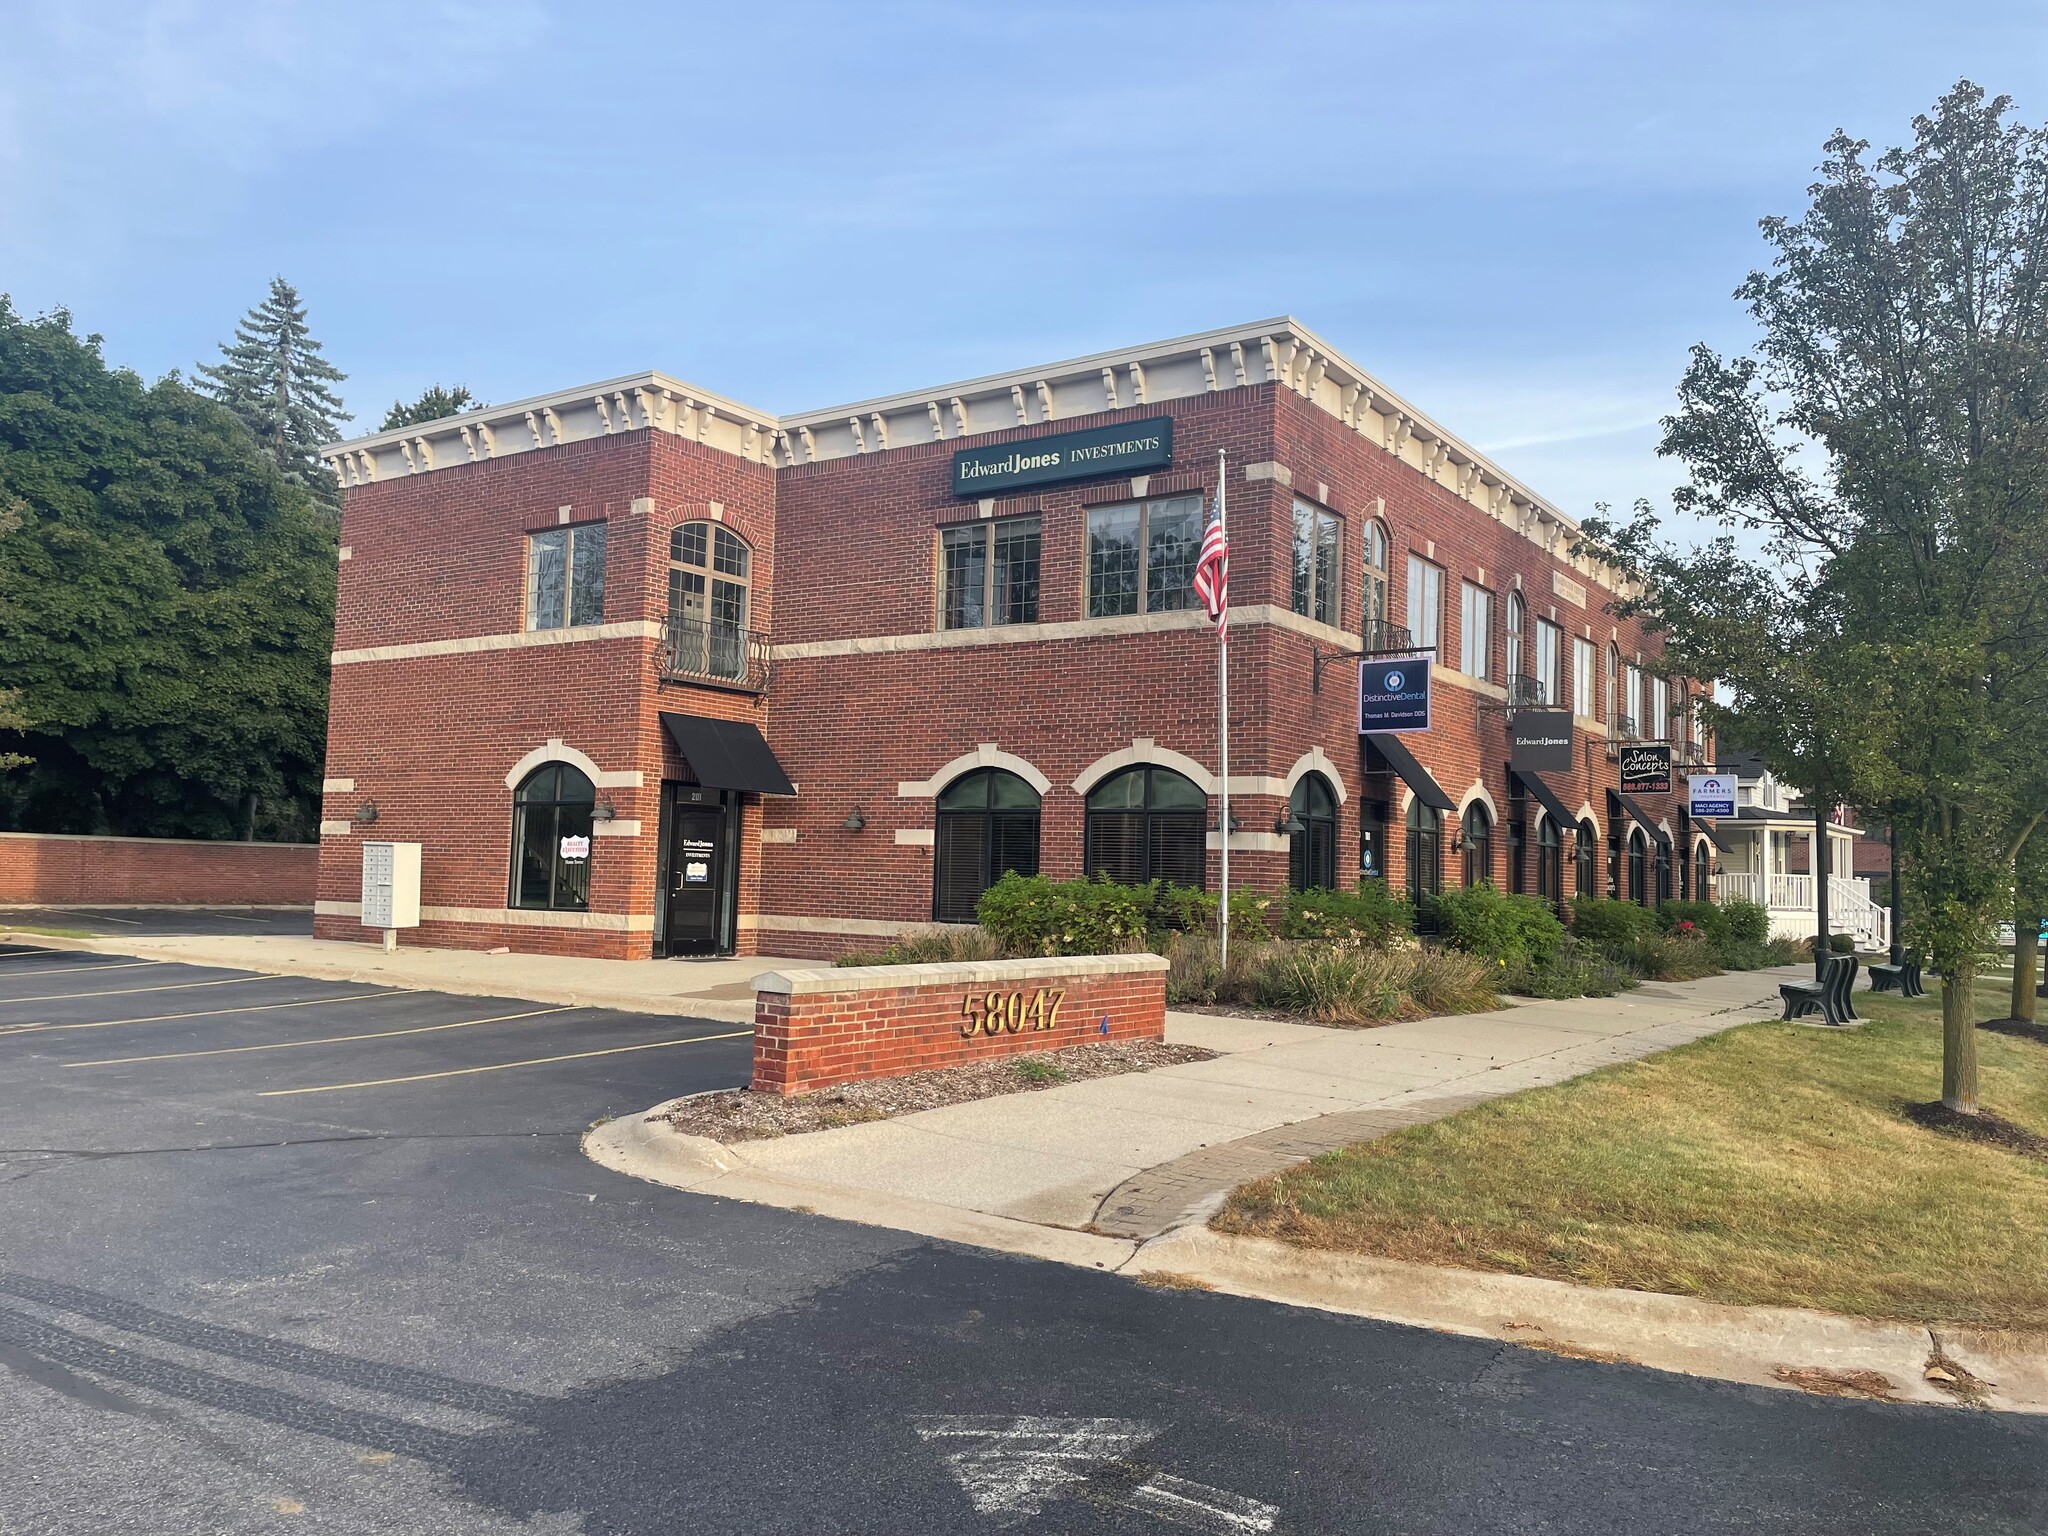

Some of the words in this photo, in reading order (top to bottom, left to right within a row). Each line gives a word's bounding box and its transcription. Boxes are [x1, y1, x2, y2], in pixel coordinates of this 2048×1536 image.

[959, 452, 1060, 480] EdwardJones
[1070, 436, 1160, 462] INVESTMENTS
[1364, 691, 1425, 702] DistinctiveDental
[1630, 749, 1659, 763] Salon
[1622, 759, 1669, 773] Concepts
[691, 792, 702, 801] 201
[960, 987, 1066, 1038] 58047
